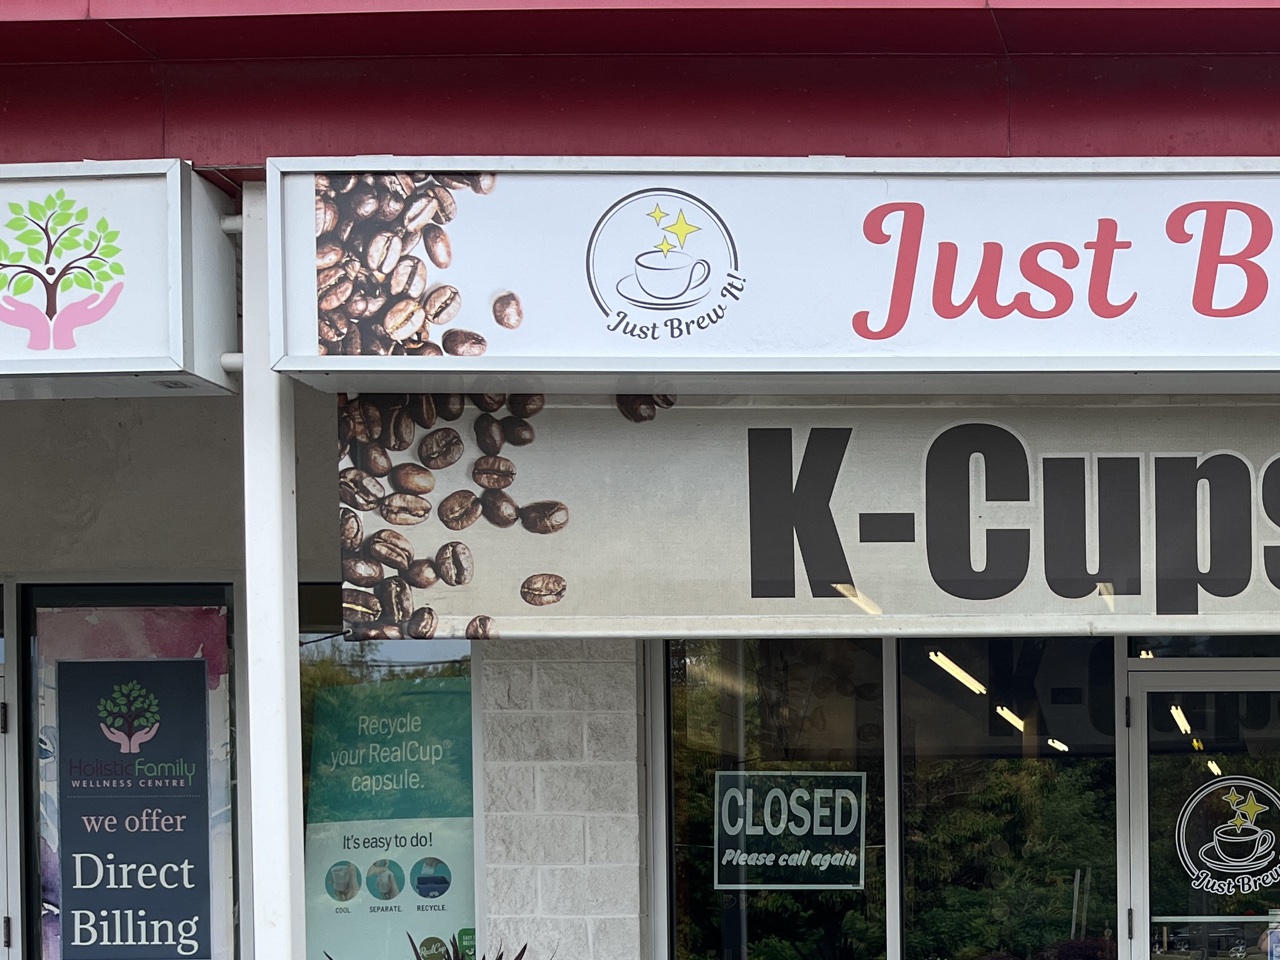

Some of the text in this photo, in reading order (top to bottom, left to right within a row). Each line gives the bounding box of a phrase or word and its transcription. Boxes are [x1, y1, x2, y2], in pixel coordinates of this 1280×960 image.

[851, 201, 1138, 341] Just
[607, 273, 747, 341] Just Brew It!
[358, 712, 421, 738] Recycle
[330, 748, 366, 771] your
[71, 779, 186, 788] WELLNESS CENTRE
[351, 769, 425, 795] capsule.
[81, 808, 187, 834] we offer
[721, 787, 859, 836] CLOSED
[362, 833, 392, 851] easy
[394, 834, 407, 848] to
[410, 832, 433, 848] do!
[71, 852, 196, 890] Direct
[721, 849, 857, 871] Please call again
[1191, 870, 1236, 895] Just
[70, 909, 200, 956] Billing
